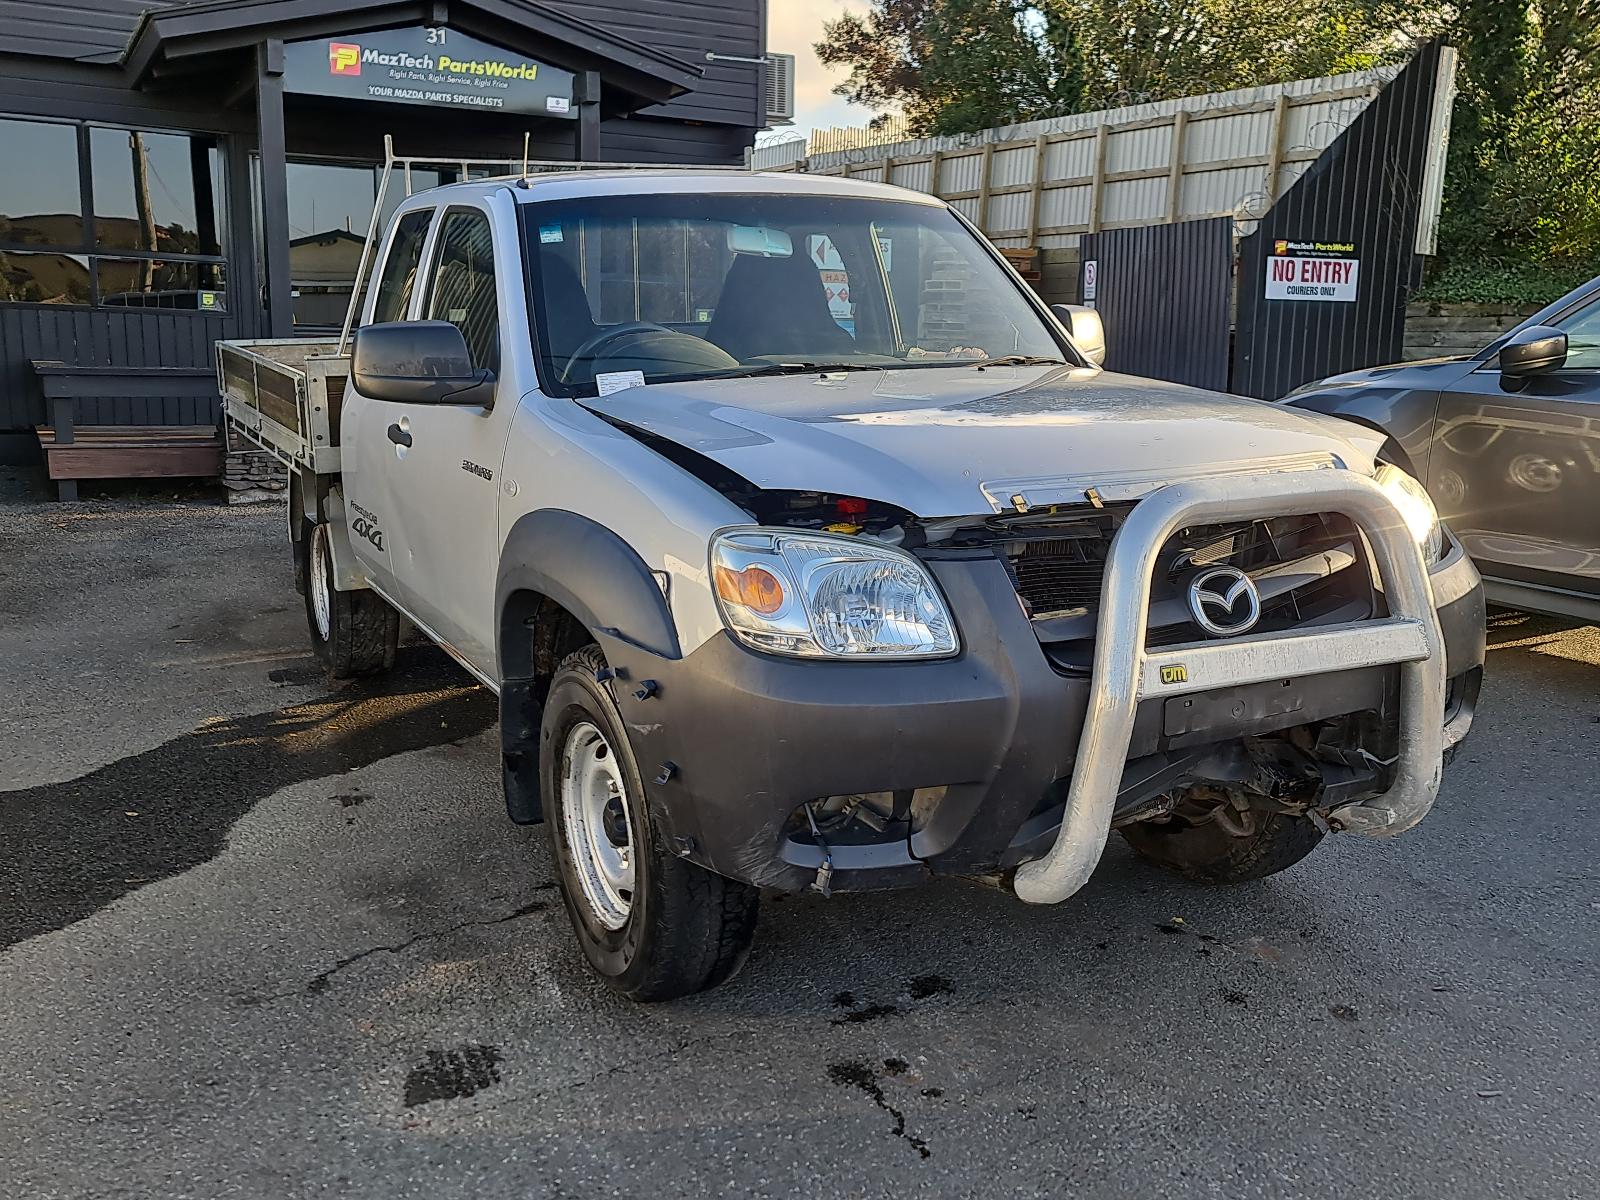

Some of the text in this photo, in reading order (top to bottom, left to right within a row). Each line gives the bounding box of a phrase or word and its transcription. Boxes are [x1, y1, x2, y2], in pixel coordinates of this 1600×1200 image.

[426, 27, 447, 45] 31
[361, 48, 434, 70] MazTech
[438, 56, 538, 80] PartsWorld
[389, 68, 407, 80] Right
[408, 71, 427, 81] Parts,
[428, 73, 446, 84] Right
[474, 78, 491, 89] Right
[492, 80, 509, 89] Price
[368, 85, 504, 107] YOUR MAZDA PARTS SPECIALISTS
[1287, 242, 1315, 250] MazTech
[1315, 242, 1355, 252] PartsWorld
[1272, 259, 1353, 285] NO ENTRY
[1286, 285, 1336, 297] COURIERS ONLY
